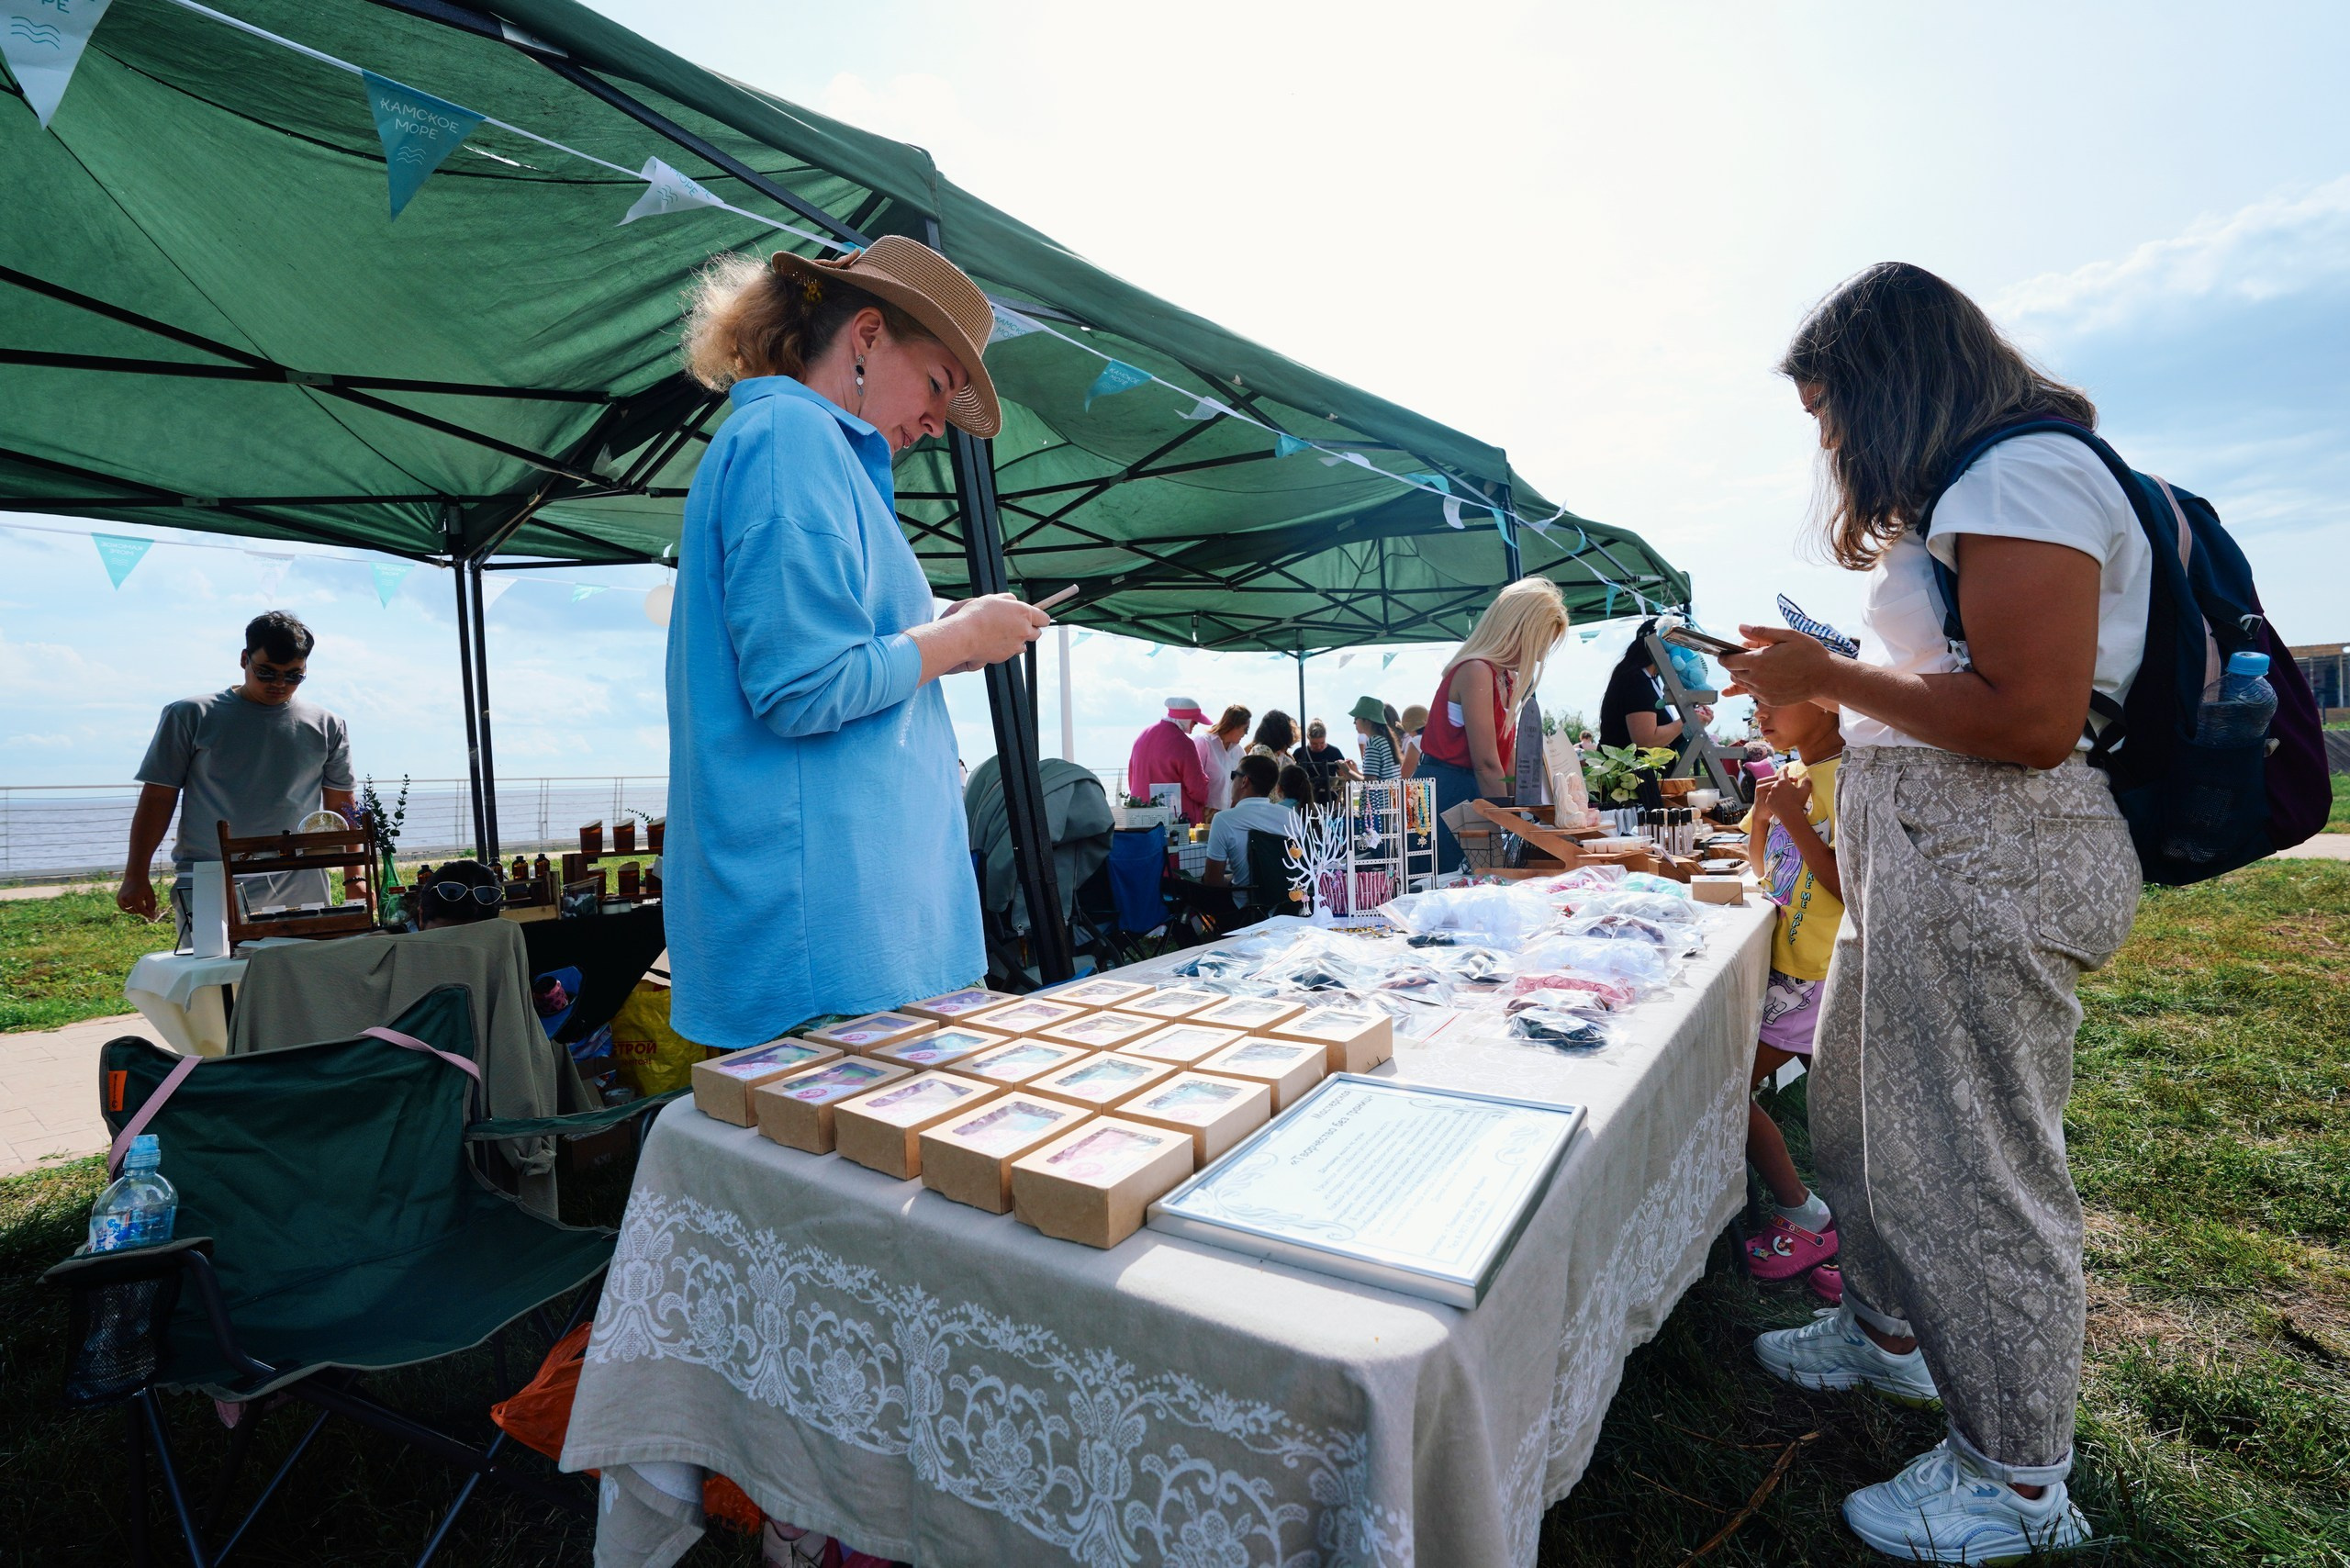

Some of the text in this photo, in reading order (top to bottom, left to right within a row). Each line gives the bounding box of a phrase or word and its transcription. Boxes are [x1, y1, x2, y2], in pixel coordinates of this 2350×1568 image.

[380, 97, 459, 134] КАМСКОЕ
[395, 118, 438, 140] МОРЕ
[1801, 891, 1811, 909] ME
[1788, 912, 1804, 946] APPY
[1311, 1090, 1351, 1119] Мастерская
[1291, 1126, 1337, 1166] «Творчество
[1331, 1116, 1350, 1127] без
